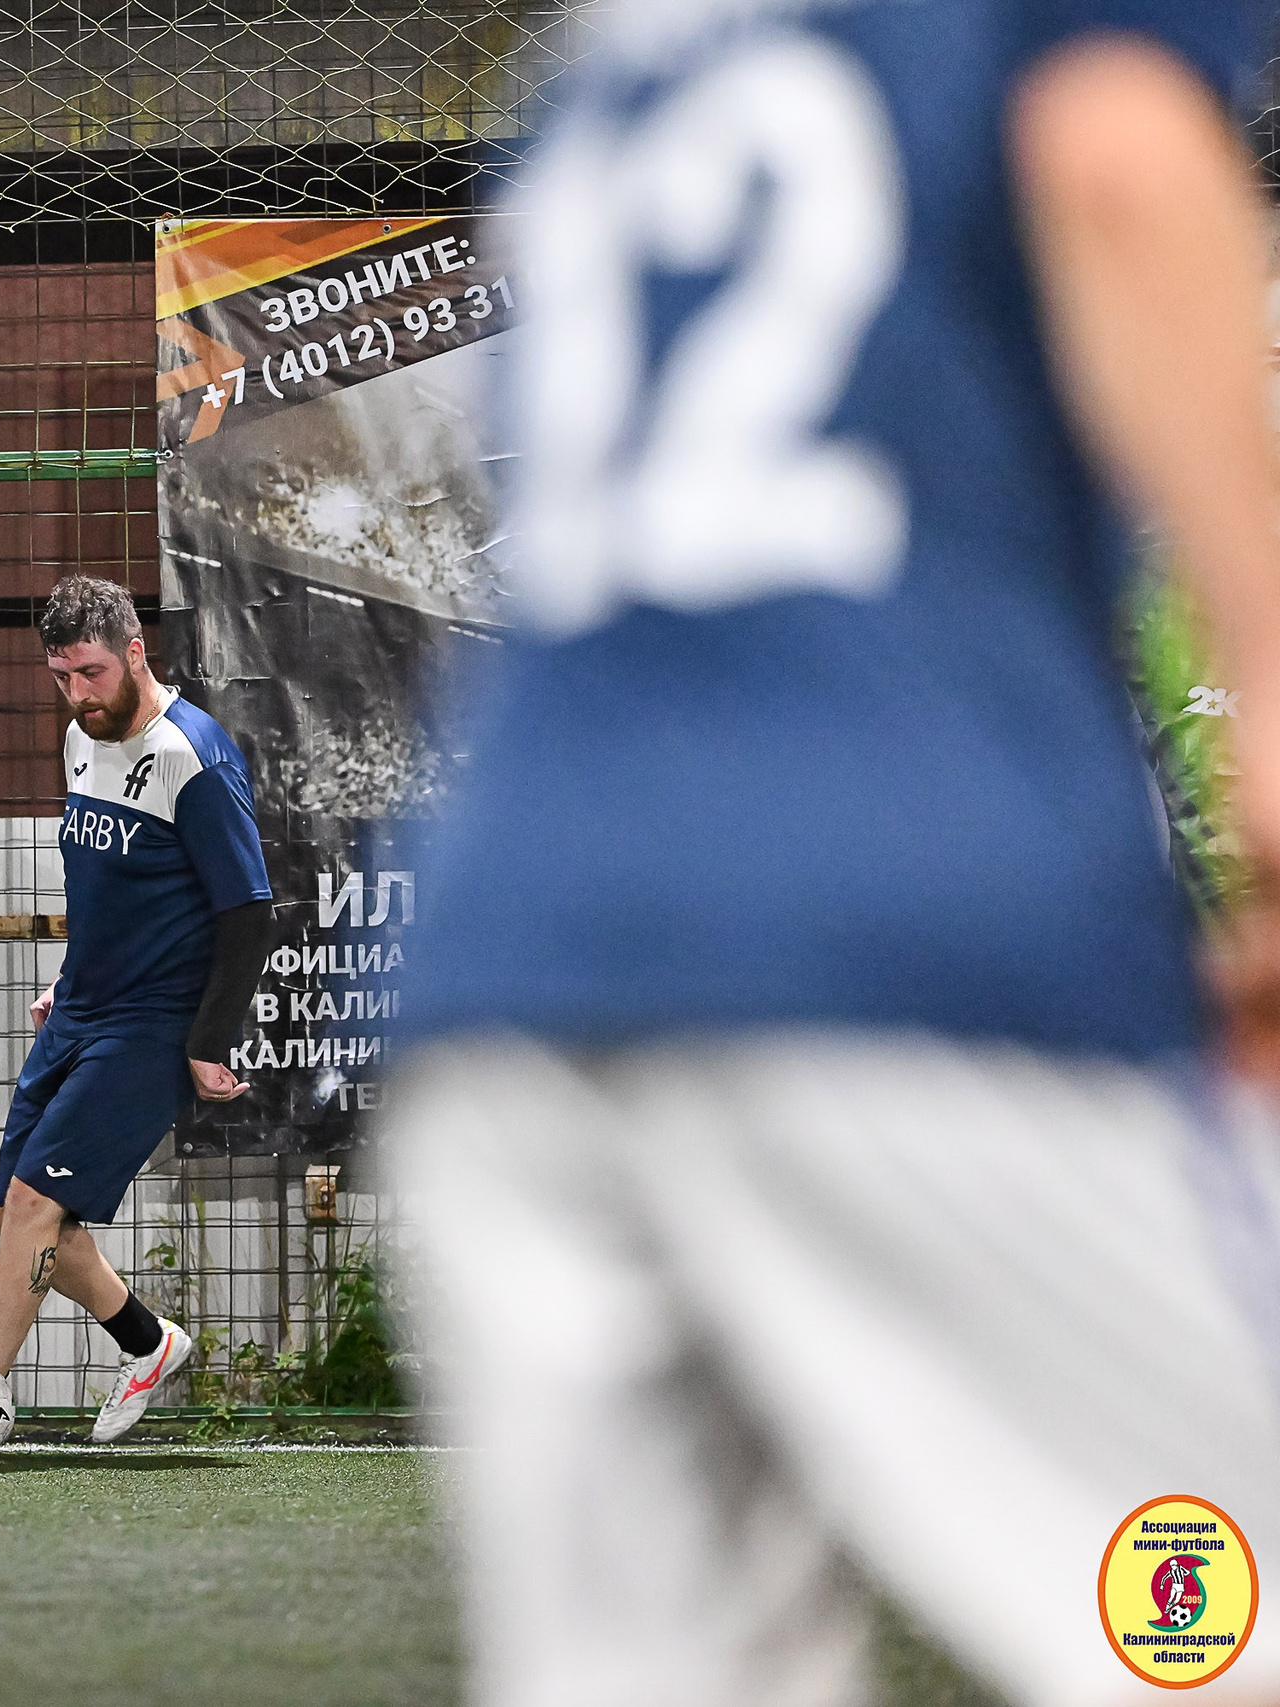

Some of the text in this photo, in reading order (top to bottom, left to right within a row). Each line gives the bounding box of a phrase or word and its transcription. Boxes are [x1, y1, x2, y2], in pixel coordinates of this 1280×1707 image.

[260, 235, 477, 333] ЗВОНИТЕ:
[202, 276, 516, 410] +7 (4012) 93 31
[518, 32, 912, 638] 12
[261, 943, 404, 980] ФИЦИА
[256, 993, 279, 1022] В
[230, 1036, 390, 1069] КАЛИНИ
